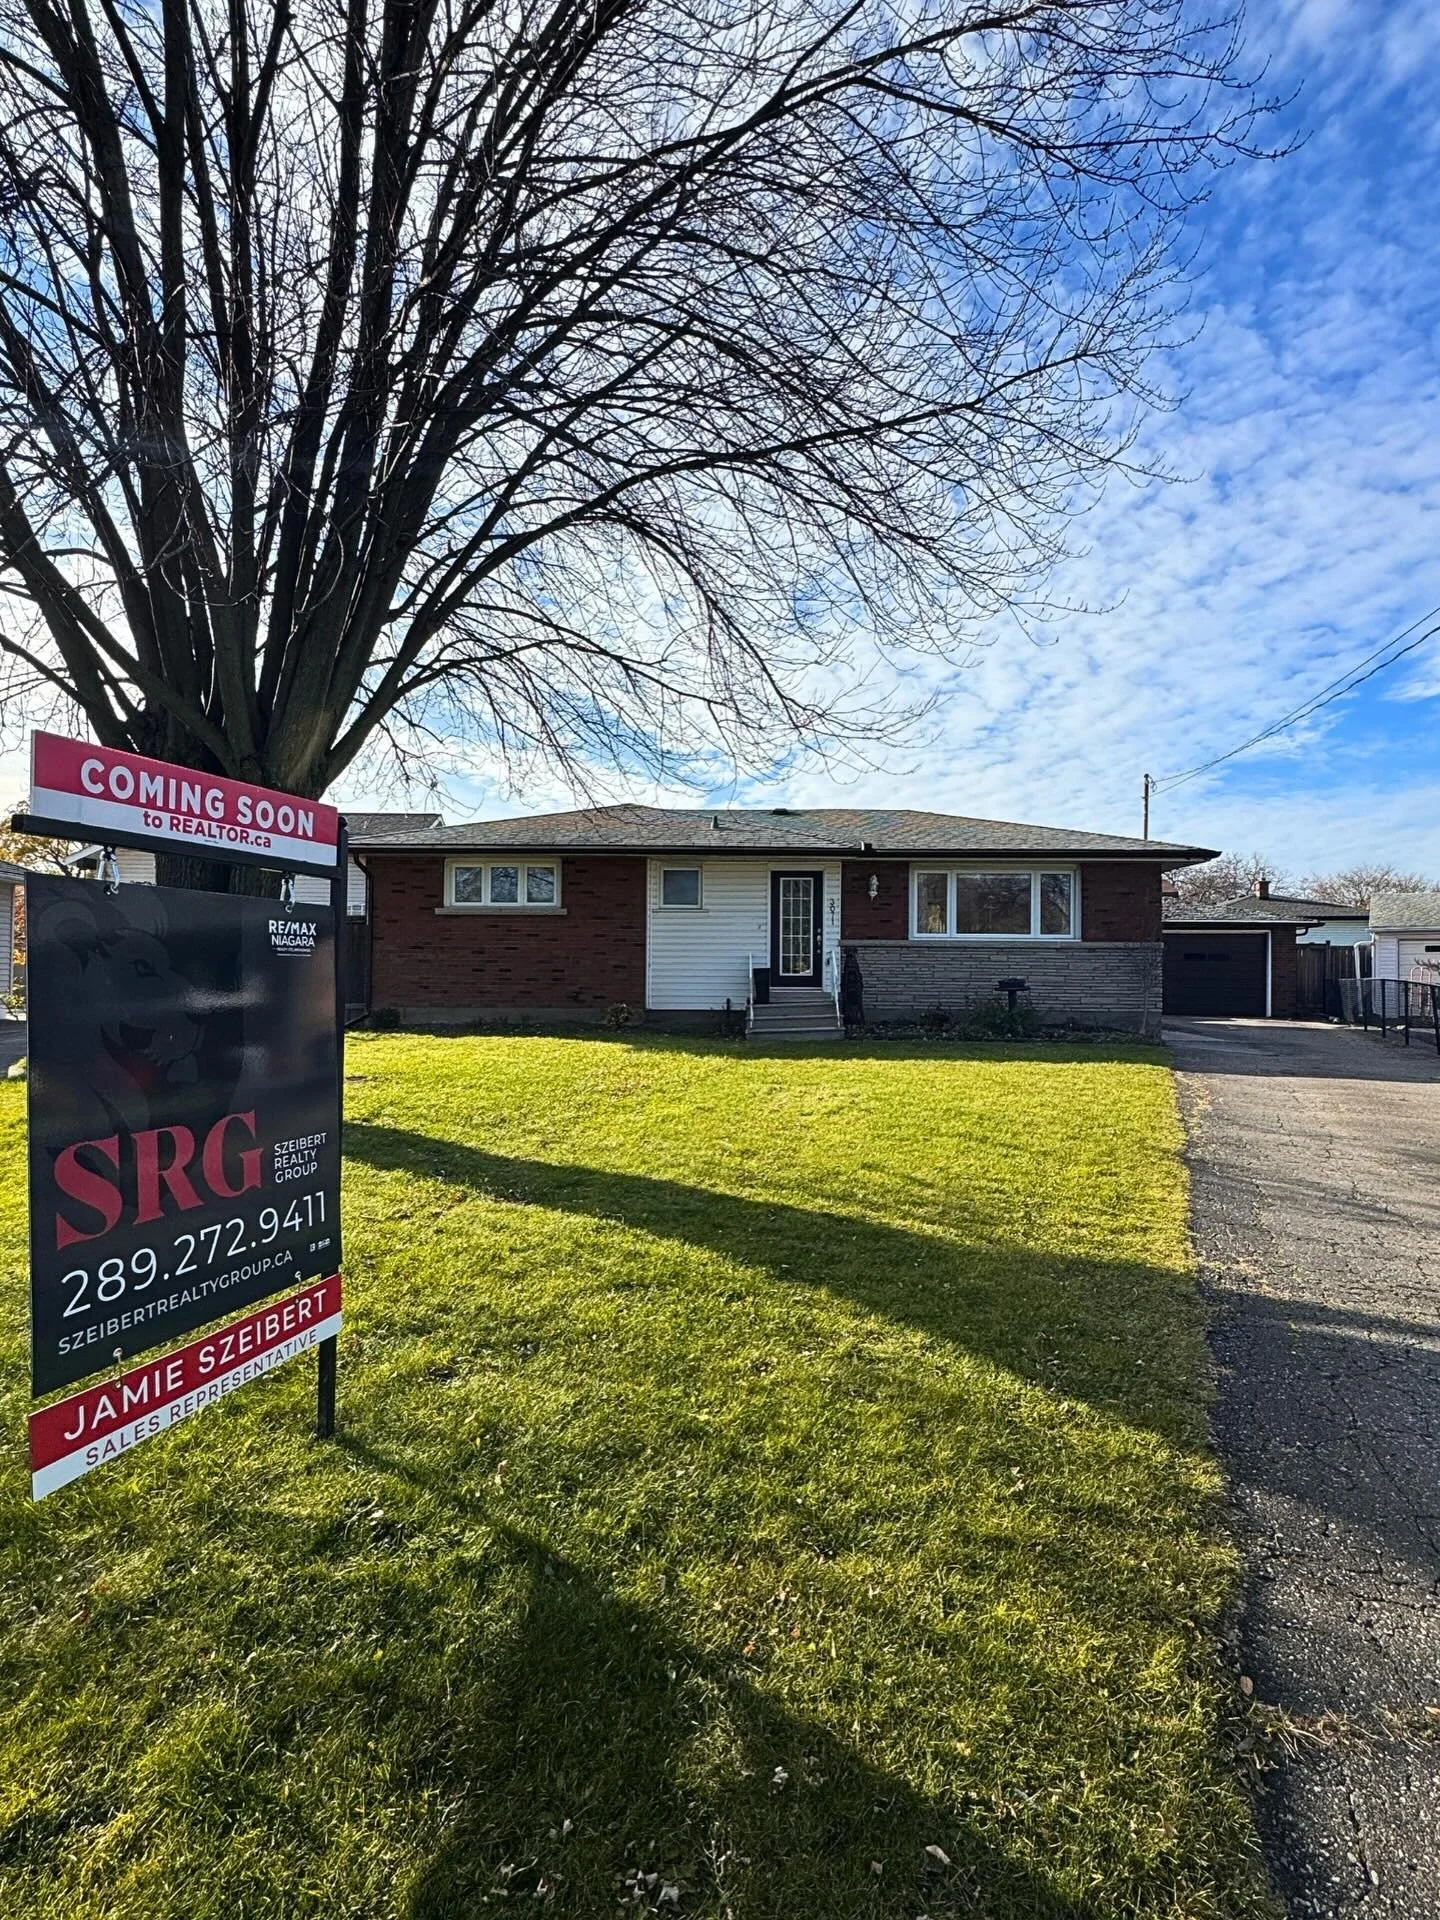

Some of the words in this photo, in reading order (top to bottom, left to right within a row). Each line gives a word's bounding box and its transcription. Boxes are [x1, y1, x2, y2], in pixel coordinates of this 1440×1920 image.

[80, 758, 225, 819] COMING
[236, 795, 314, 838] SOON
[143, 810, 163, 829] to
[169, 815, 272, 849] REALTOR.ca
[268, 919, 317, 936] RE/MAX
[271, 934, 316, 947] NIAGARA
[274, 1132, 328, 1156] SZEIBERT
[274, 1148, 317, 1169] REALTY
[275, 1161, 318, 1183] GROUP
[53, 1109, 265, 1251] SRG
[61, 1190, 327, 1318] 289.272.9411
[57, 1250, 294, 1355] SZEIBERTREALTYGROUP.CA
[63, 1358, 185, 1441] JAMIE
[198, 1289, 327, 1374] SZEIBERT
[85, 1415, 161, 1467] SALES
[169, 1328, 318, 1420] REPRESENTATIVE
